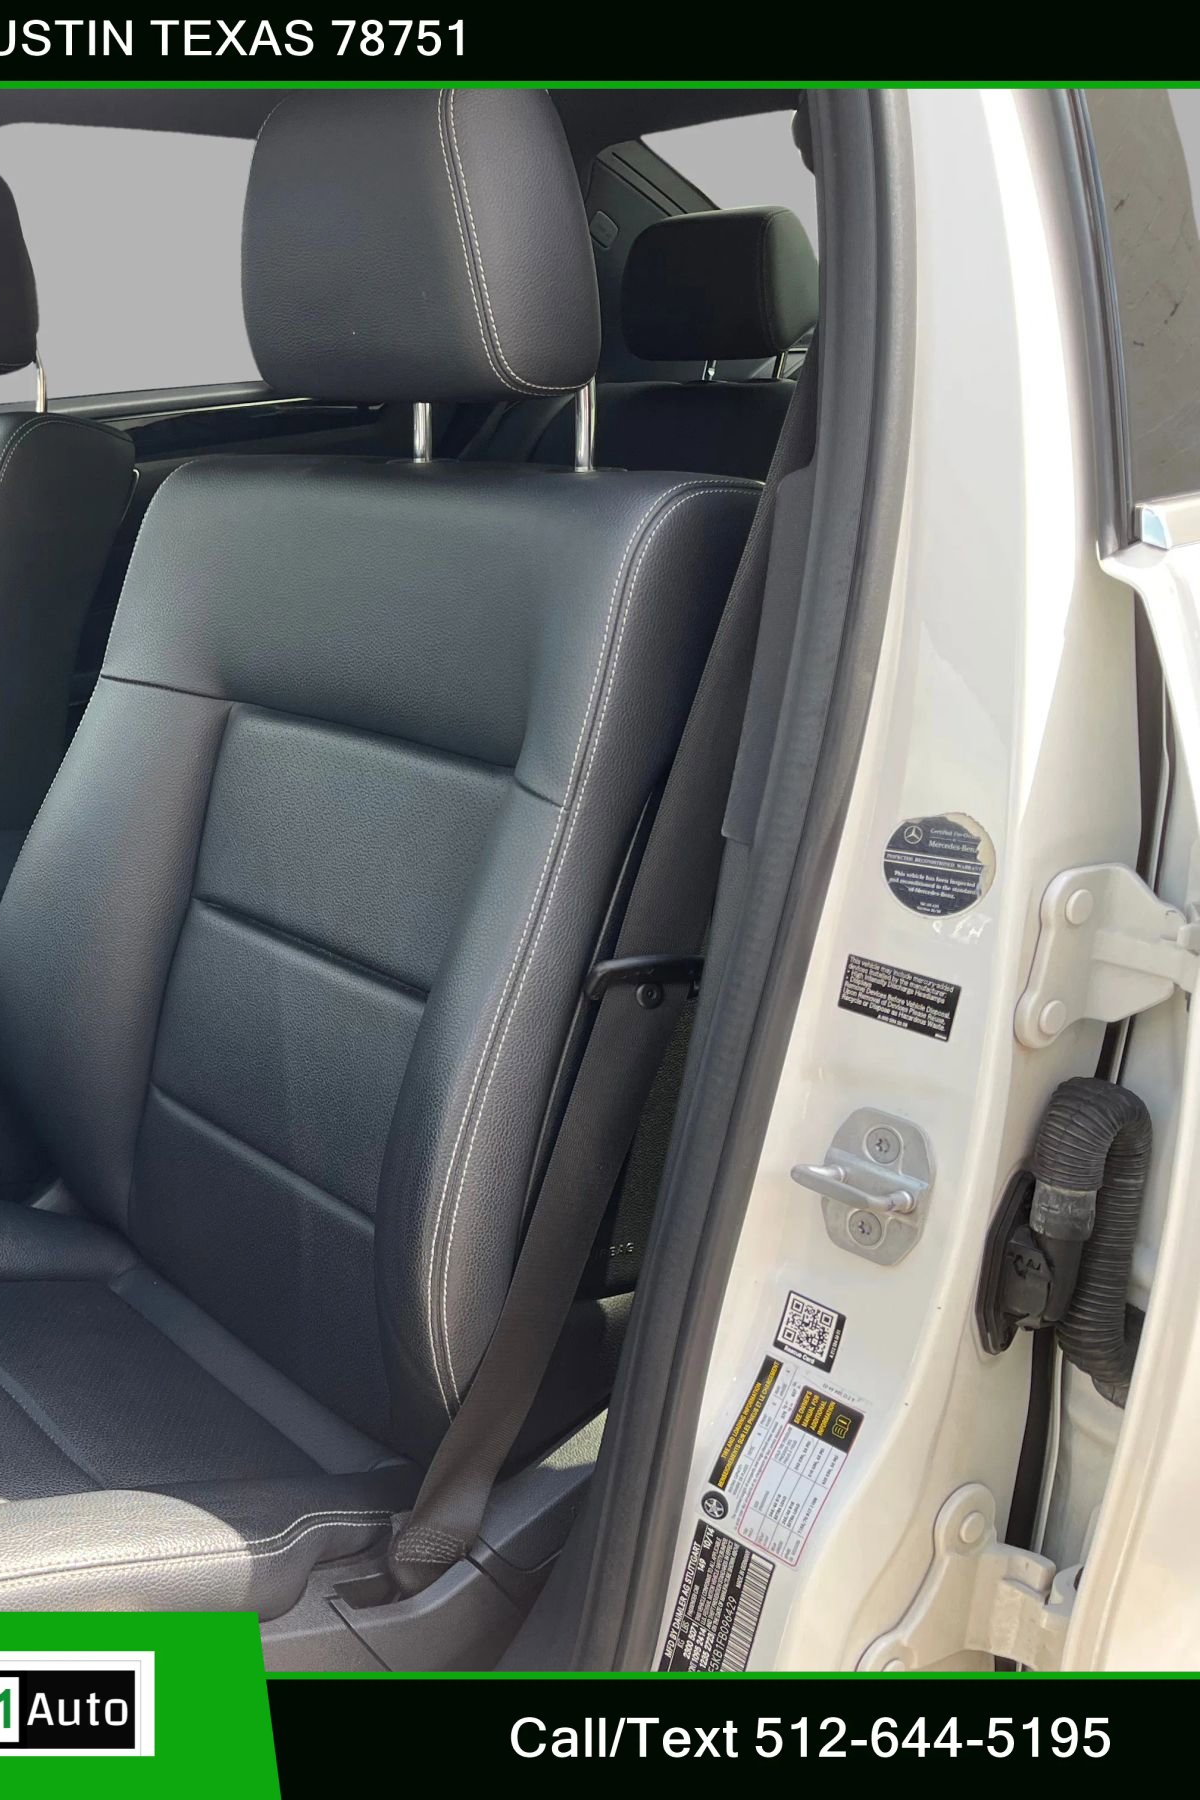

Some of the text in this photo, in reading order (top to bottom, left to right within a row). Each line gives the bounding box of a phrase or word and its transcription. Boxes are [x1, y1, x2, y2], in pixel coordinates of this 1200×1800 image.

[899, 878, 934, 888] reconditioned
[906, 871, 924, 879] vehicle
[949, 879, 975, 888] inspected
[849, 956, 860, 964] This
[860, 960, 880, 971] vehicle
[879, 966, 892, 975] may
[892, 969, 912, 980] include
[891, 976, 898, 984] by
[898, 978, 908, 986] the
[865, 988, 887, 999] Devices
[886, 994, 905, 1005] Before
[905, 1000, 926, 1011] Vehicle
[886, 982, 914, 995] Discharge
[914, 989, 945, 1004] Headlamps
[840, 993, 862, 1005] Recycle
[868, 1002, 891, 1015] Dispose
[897, 1011, 927, 1025] Hazardous
[886, 1001, 908, 1012] Devices
[908, 1008, 927, 1018] Please
[802, 1354, 815, 1364] Card
[797, 1389, 813, 1413] OWNER'S
[800, 1404, 815, 1427] MANUAL
[810, 1394, 820, 1406] FOR
[720, 1446, 730, 1459] TIRE
[725, 1435, 736, 1448] AND
[731, 1413, 747, 1438] LOADING
[741, 1380, 762, 1416] INFORMATION
[792, 1412, 803, 1424] SEE
[809, 1399, 828, 1431] ADDITIONAL
[816, 1400, 837, 1436] INFORMATION
[736, 1432, 747, 1445] SUR
[741, 1423, 751, 1434] LES
[696, 1558, 707, 1571] 149
[702, 1526, 716, 1549] 10/14
[739, 1548, 751, 1570] GERMANY
[663, 1540, 702, 1658] MFD BY DAIMLER AG STUTTGART
[675, 1619, 690, 1649] KG LBS
[682, 1622, 699, 1659] 2300 5071
[694, 1626, 707, 1646] 2414
[690, 1645, 702, 1663] 1095
[698, 1631, 715, 1668] 1235 2723
